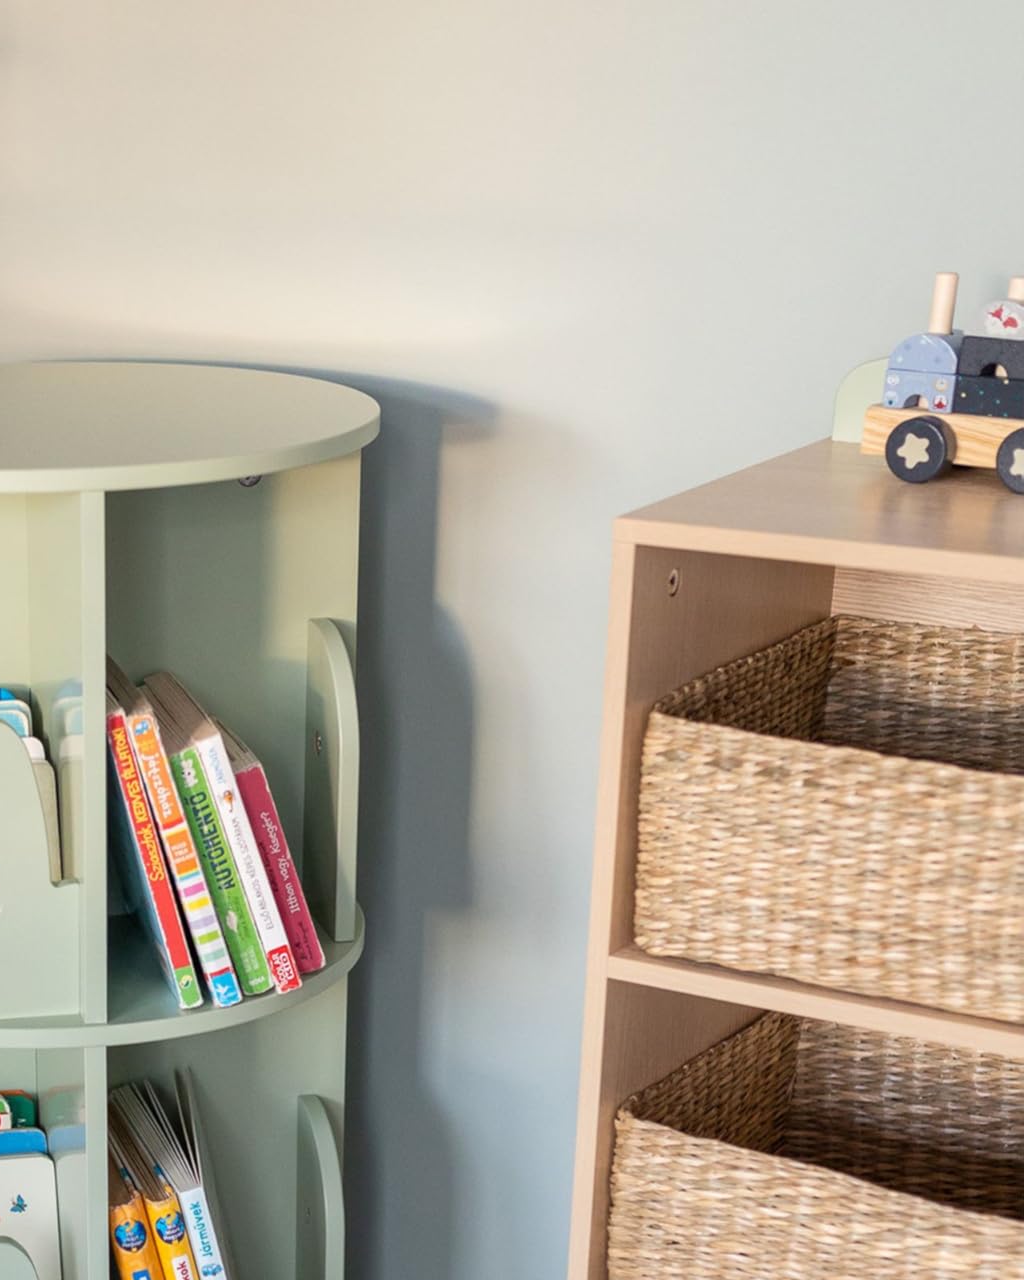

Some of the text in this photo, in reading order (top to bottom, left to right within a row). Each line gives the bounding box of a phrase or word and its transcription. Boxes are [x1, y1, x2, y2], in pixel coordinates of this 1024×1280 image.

[127, 781, 148, 824] KEDVES
[285, 882, 300, 914] Itthon
[279, 952, 294, 979] KID
[189, 1201, 213, 1257] Járművek
